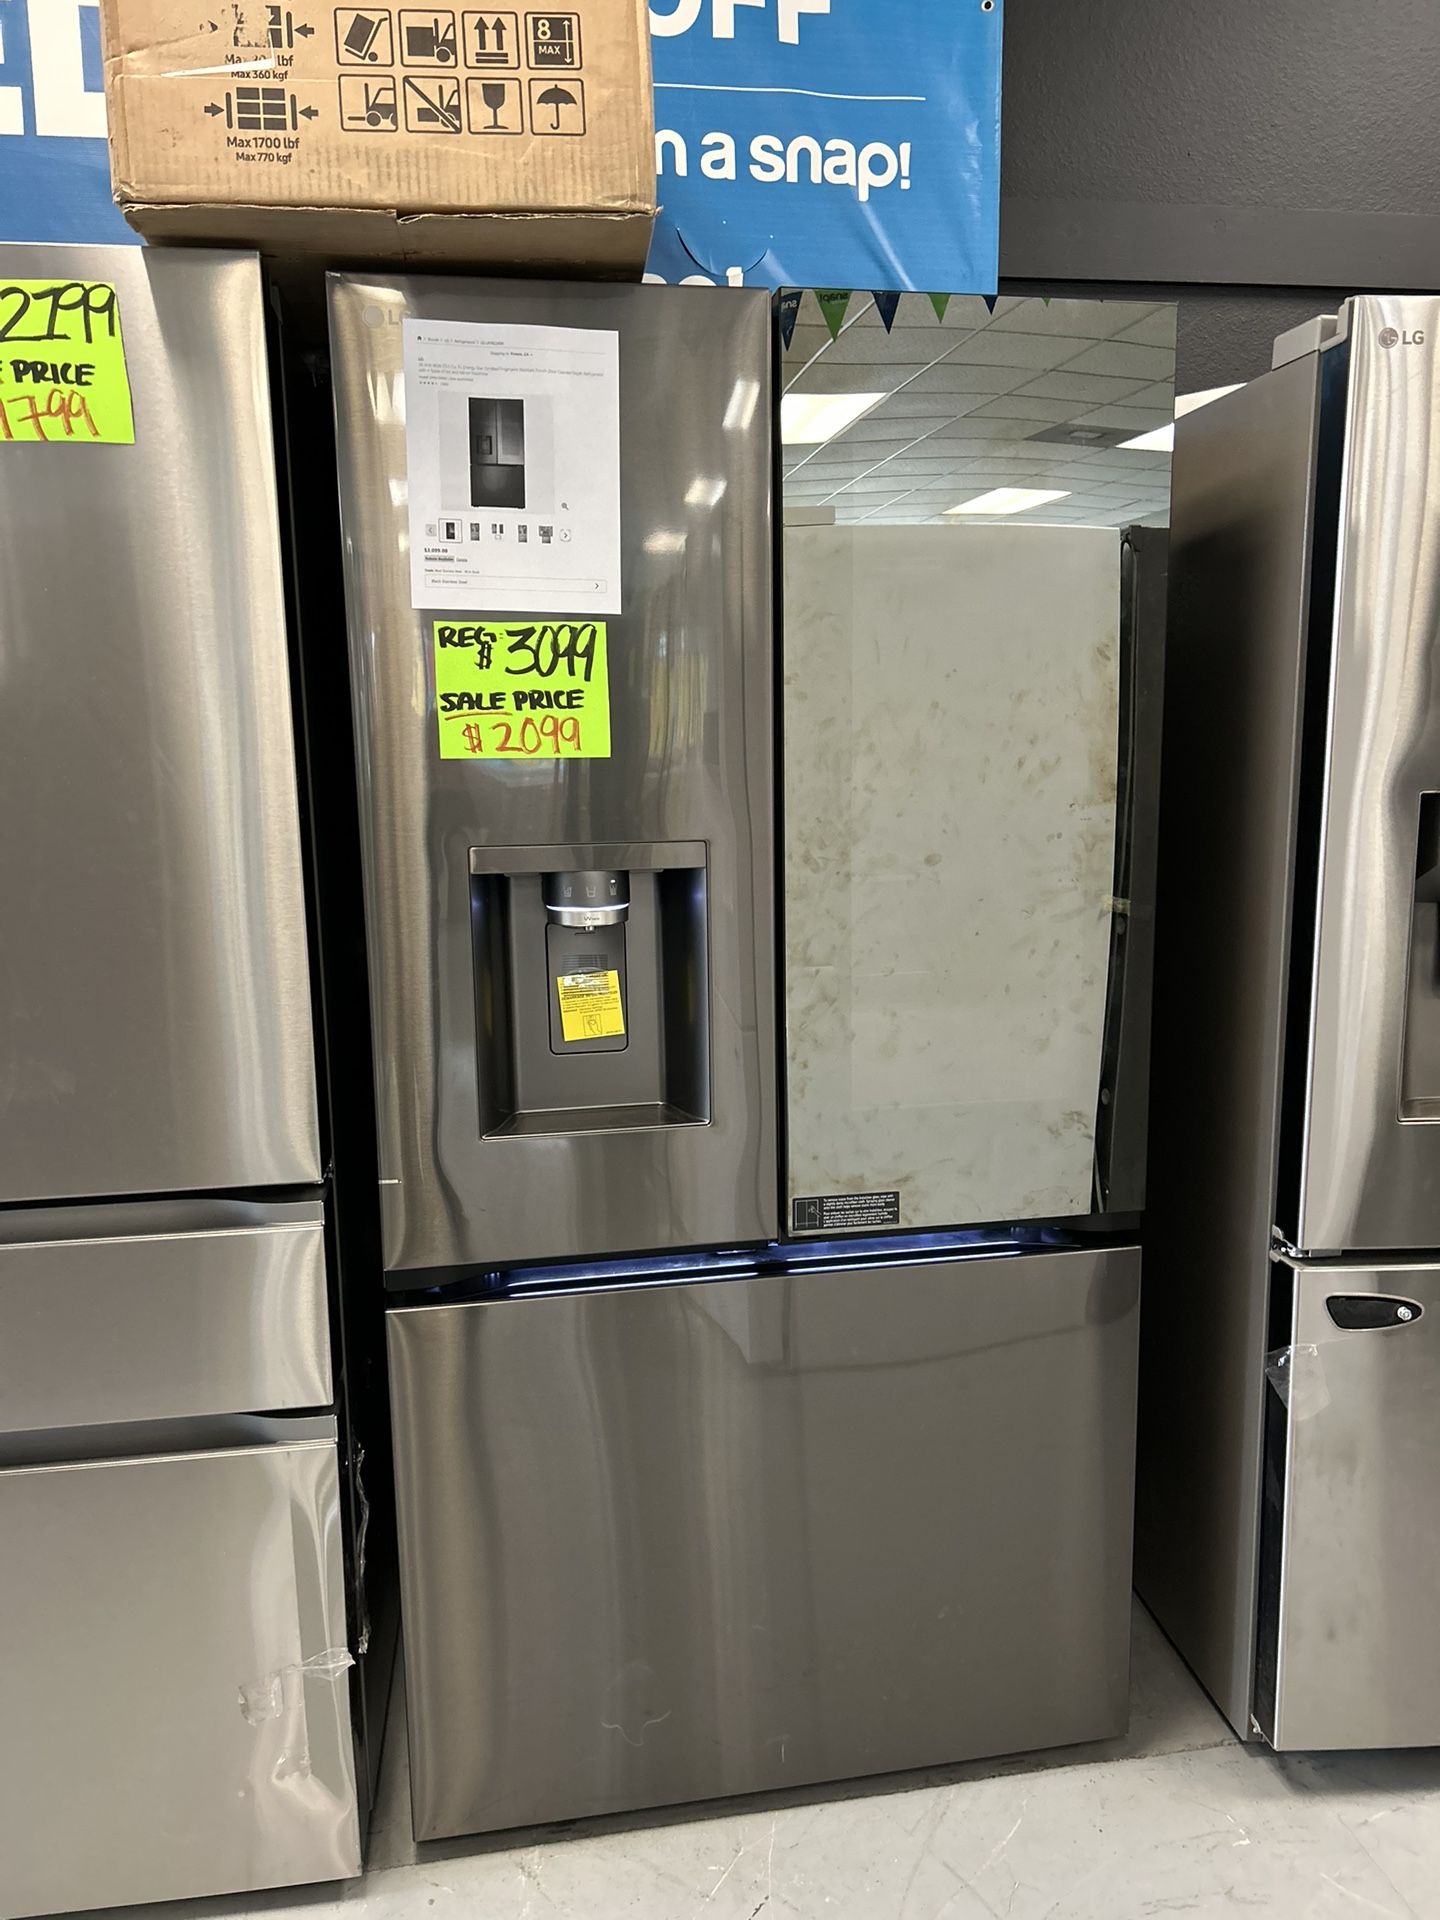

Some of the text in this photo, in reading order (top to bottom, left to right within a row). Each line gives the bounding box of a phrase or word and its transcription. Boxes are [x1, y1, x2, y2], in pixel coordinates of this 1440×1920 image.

[537, 18, 551, 40] 8
[538, 45, 560, 55] MAX
[277, 54, 294, 67] lbf
[231, 69, 288, 82] Max 360 kgf
[226, 136, 300, 149] Max 1700 lbf
[236, 152, 292, 165] Max 770 kgf
[700, 131, 736, 180] a
[749, 134, 912, 203] snap!
[1402, 330, 1425, 345] LG
[10, 359, 96, 386] PRICE
[440, 689, 585, 712] SALE PRICE
